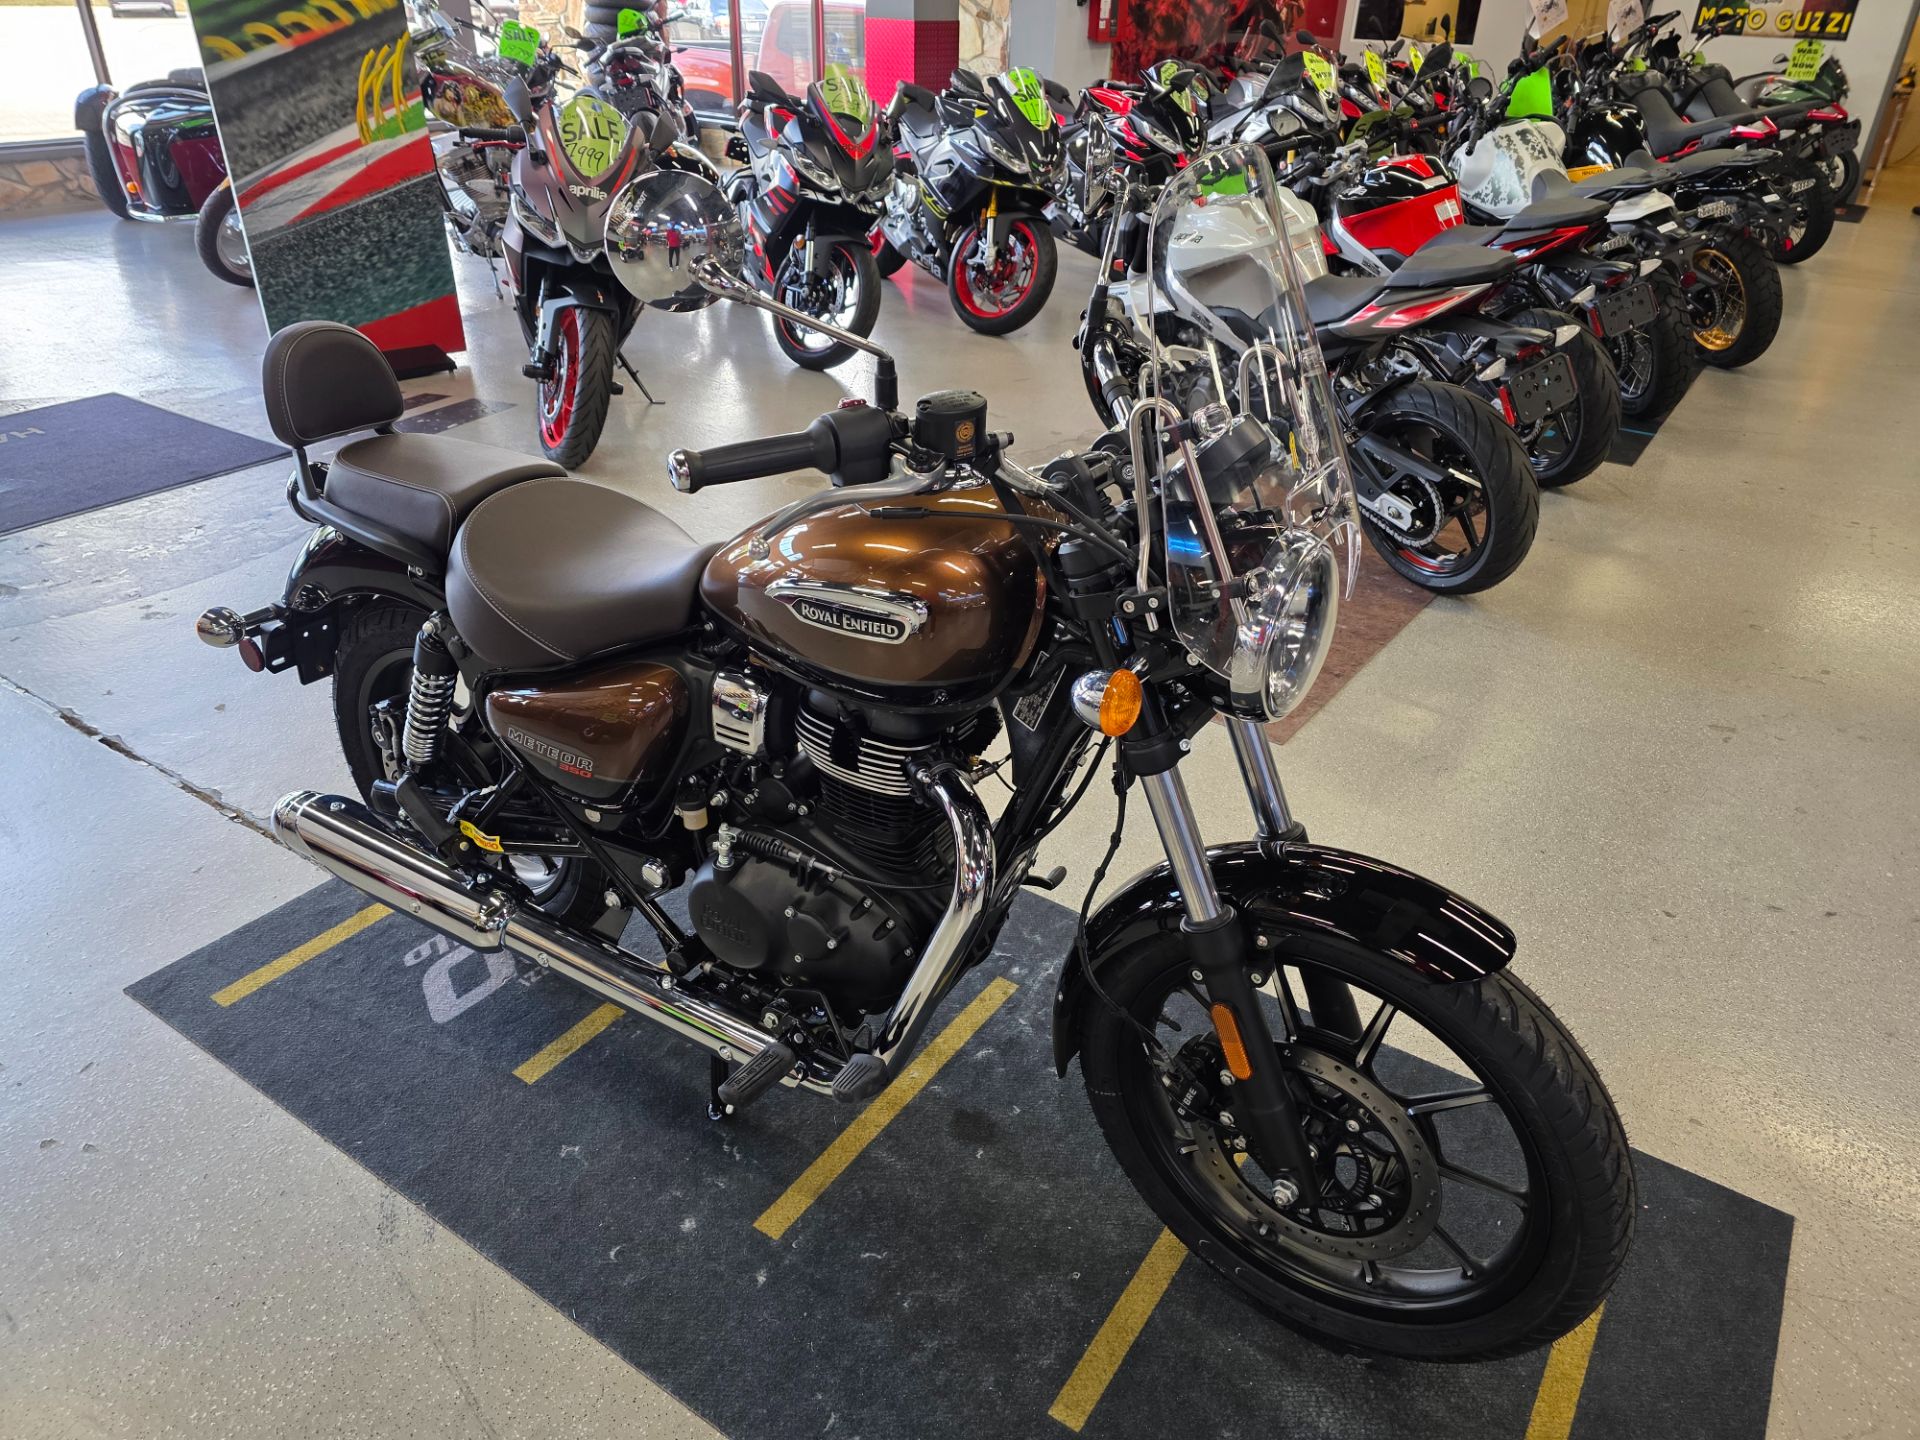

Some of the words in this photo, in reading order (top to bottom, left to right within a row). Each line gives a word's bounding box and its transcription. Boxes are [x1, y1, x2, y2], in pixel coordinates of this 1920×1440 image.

[1775, 11, 1852, 33] GUZZI
[504, 29, 536, 43] SALE
[561, 117, 620, 144] SALE
[568, 184, 608, 200] aprilia
[801, 602, 841, 626] ROYAL
[842, 613, 899, 637] ENFIELD
[507, 727, 593, 771] METEOR
[559, 763, 593, 778] 350
[1177, 1087, 1197, 1116] BBRE
